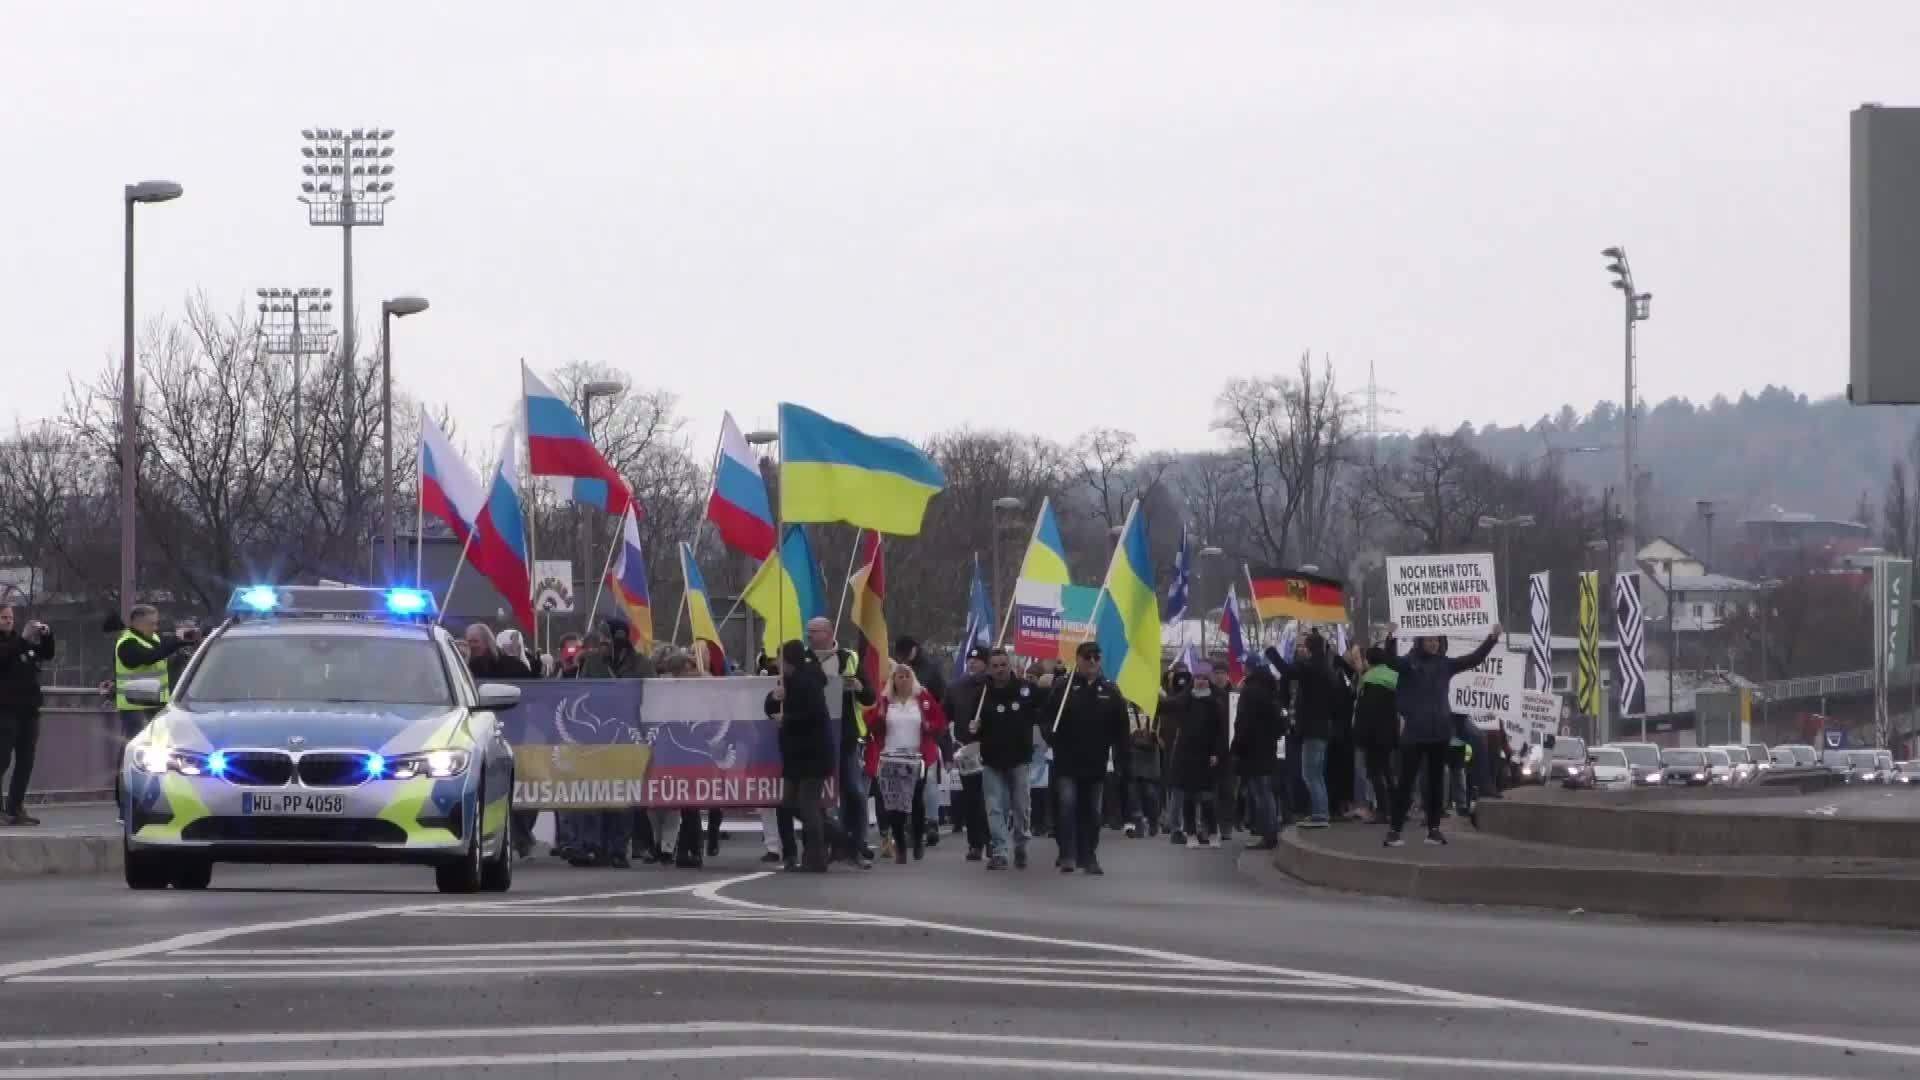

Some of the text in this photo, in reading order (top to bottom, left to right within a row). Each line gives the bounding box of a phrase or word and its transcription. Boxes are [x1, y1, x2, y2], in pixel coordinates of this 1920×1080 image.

[1400, 563, 1482, 579] NOCH MEHR TOTE,
[1393, 582, 1420, 596] NOCH
[1422, 581, 1448, 595] MEHR
[1406, 595, 1481, 612] WERDEN KEINEN
[1022, 615, 1036, 627] ICH
[1037, 616, 1051, 629] BIN
[1400, 611, 1489, 629] FRIEDEN SCHAFFEN
[1456, 686, 1510, 711] RÜSTUNG
[511, 779, 642, 803] ZUSAMMEN
[648, 775, 689, 801] FÜR
[695, 778, 739, 801] DEN
[283, 795, 301, 812] PP
[306, 795, 342, 812] 4058
